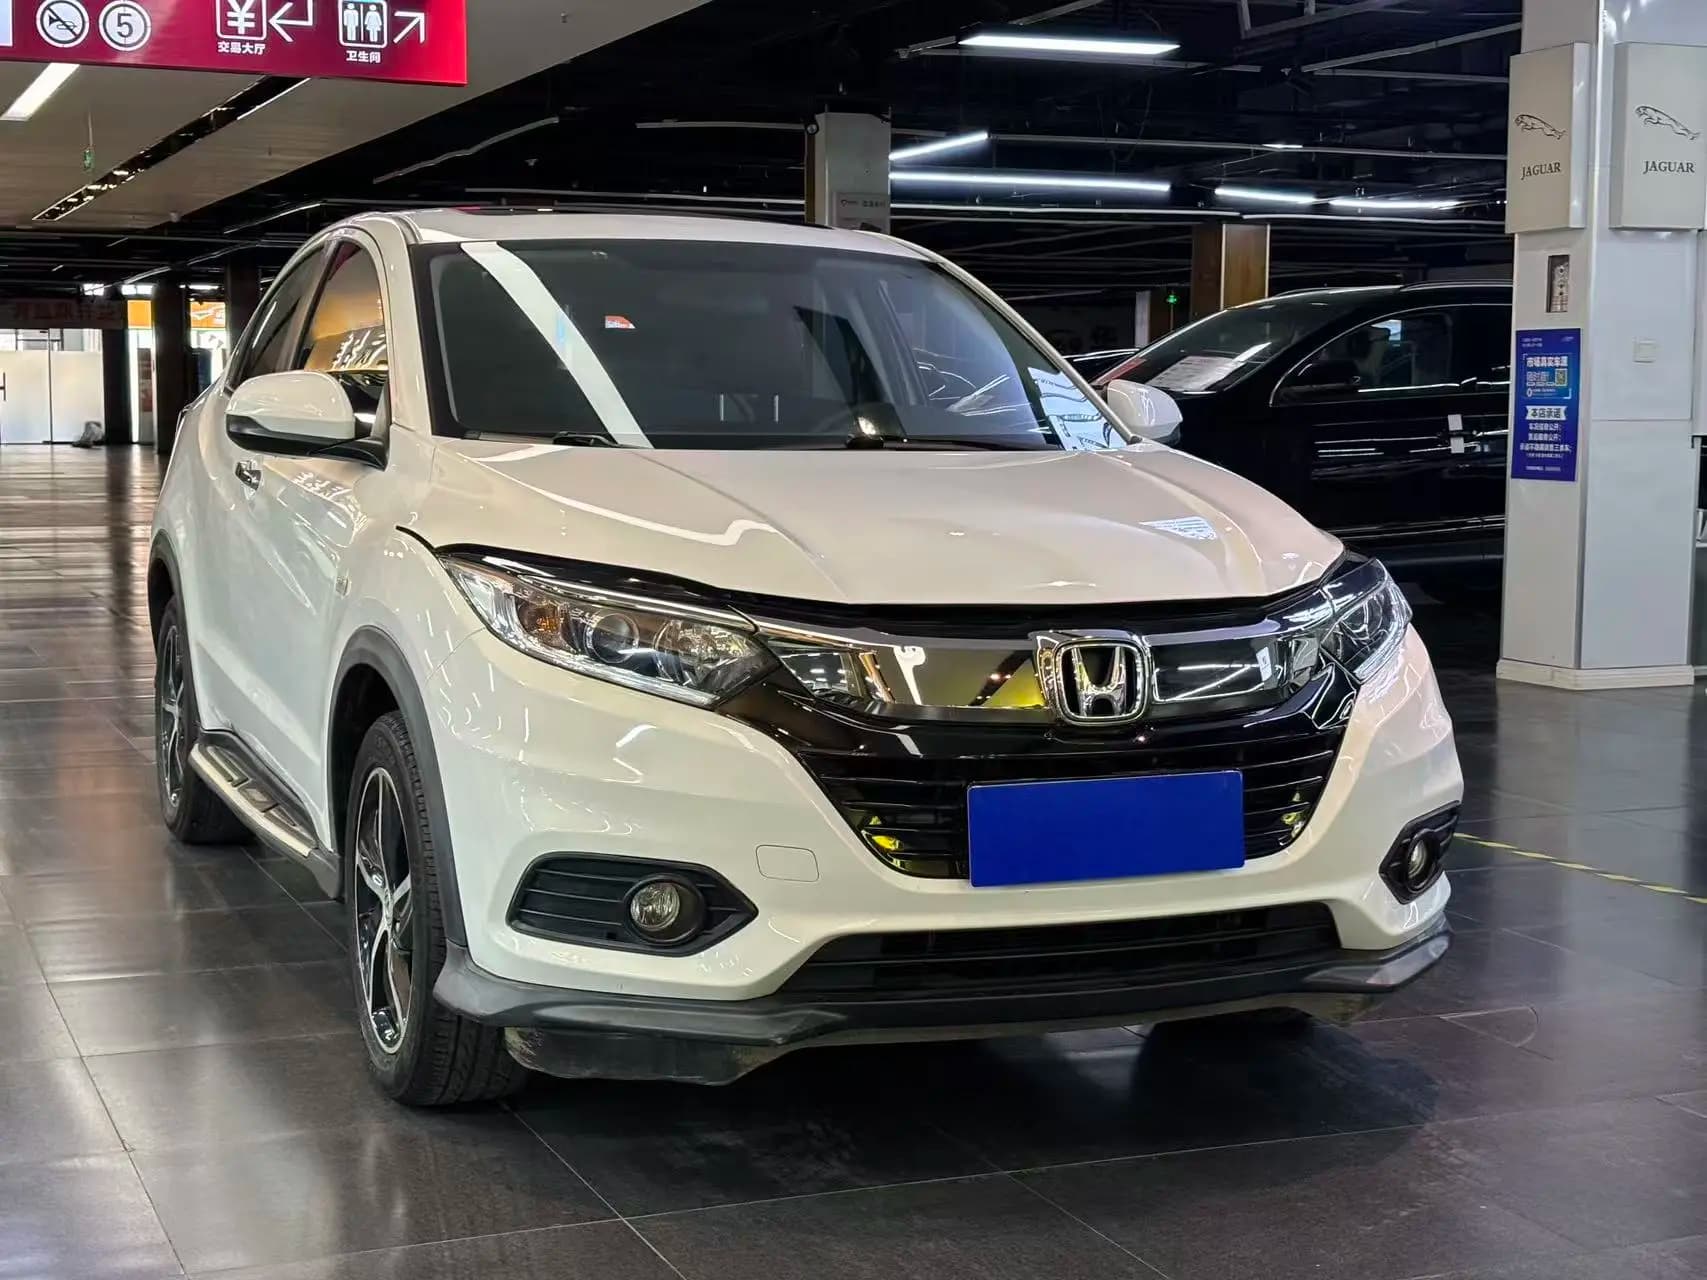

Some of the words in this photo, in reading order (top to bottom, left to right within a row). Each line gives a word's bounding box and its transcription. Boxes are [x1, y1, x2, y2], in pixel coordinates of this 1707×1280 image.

[117, 13, 133, 35] 5
[217, 41, 266, 55] 交易大厅
[346, 50, 381, 63] 卫生间
[1521, 162, 1561, 180] JAGUAR
[1643, 160, 1695, 174] JAGUAR
